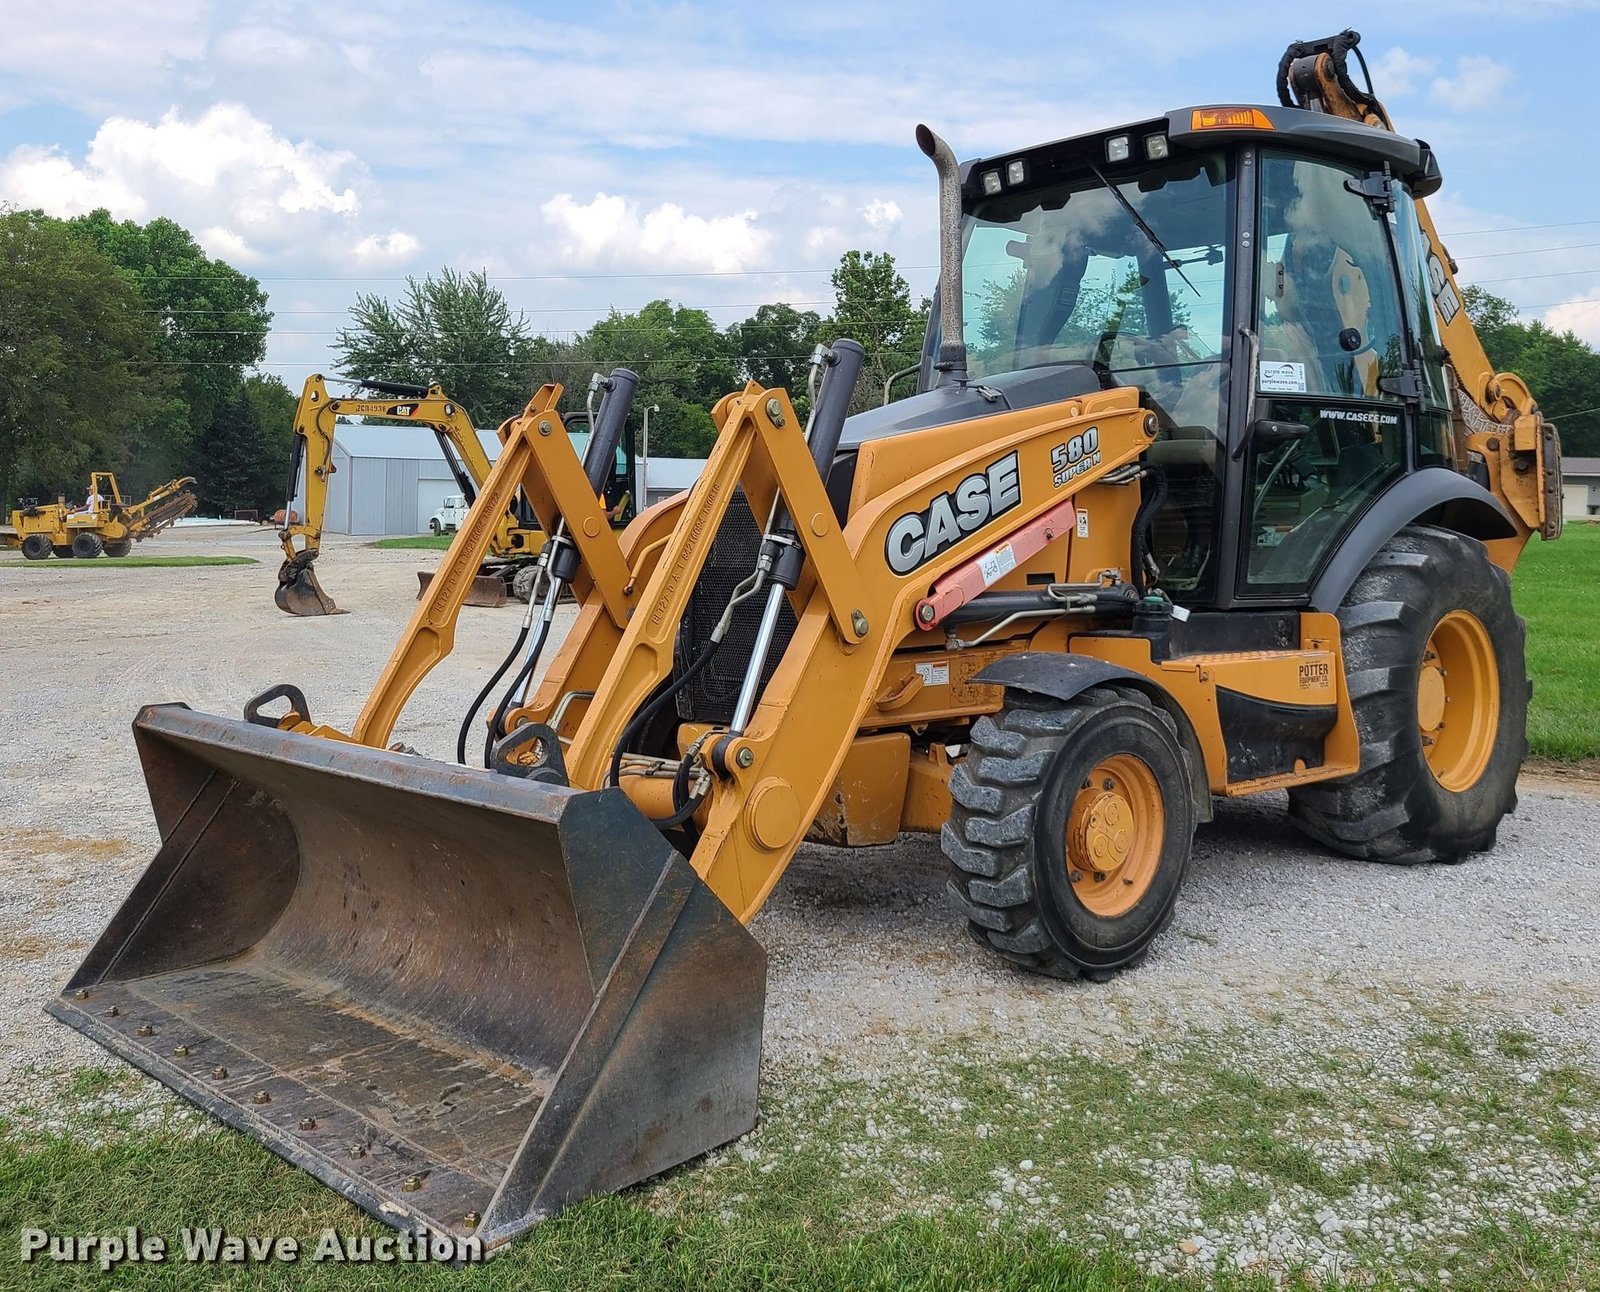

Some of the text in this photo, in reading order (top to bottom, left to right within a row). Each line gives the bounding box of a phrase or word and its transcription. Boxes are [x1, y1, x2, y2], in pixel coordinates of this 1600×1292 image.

[396, 405, 411, 416] CAT
[1320, 410, 1397, 424] WWW.CASECE.COM
[1050, 426, 1099, 473] 580
[1053, 451, 1102, 488] SUPER N
[885, 449, 1022, 576] CASE
[1299, 664, 1328, 676] POTTER
[1299, 676, 1321, 684] EQUIPMENT
